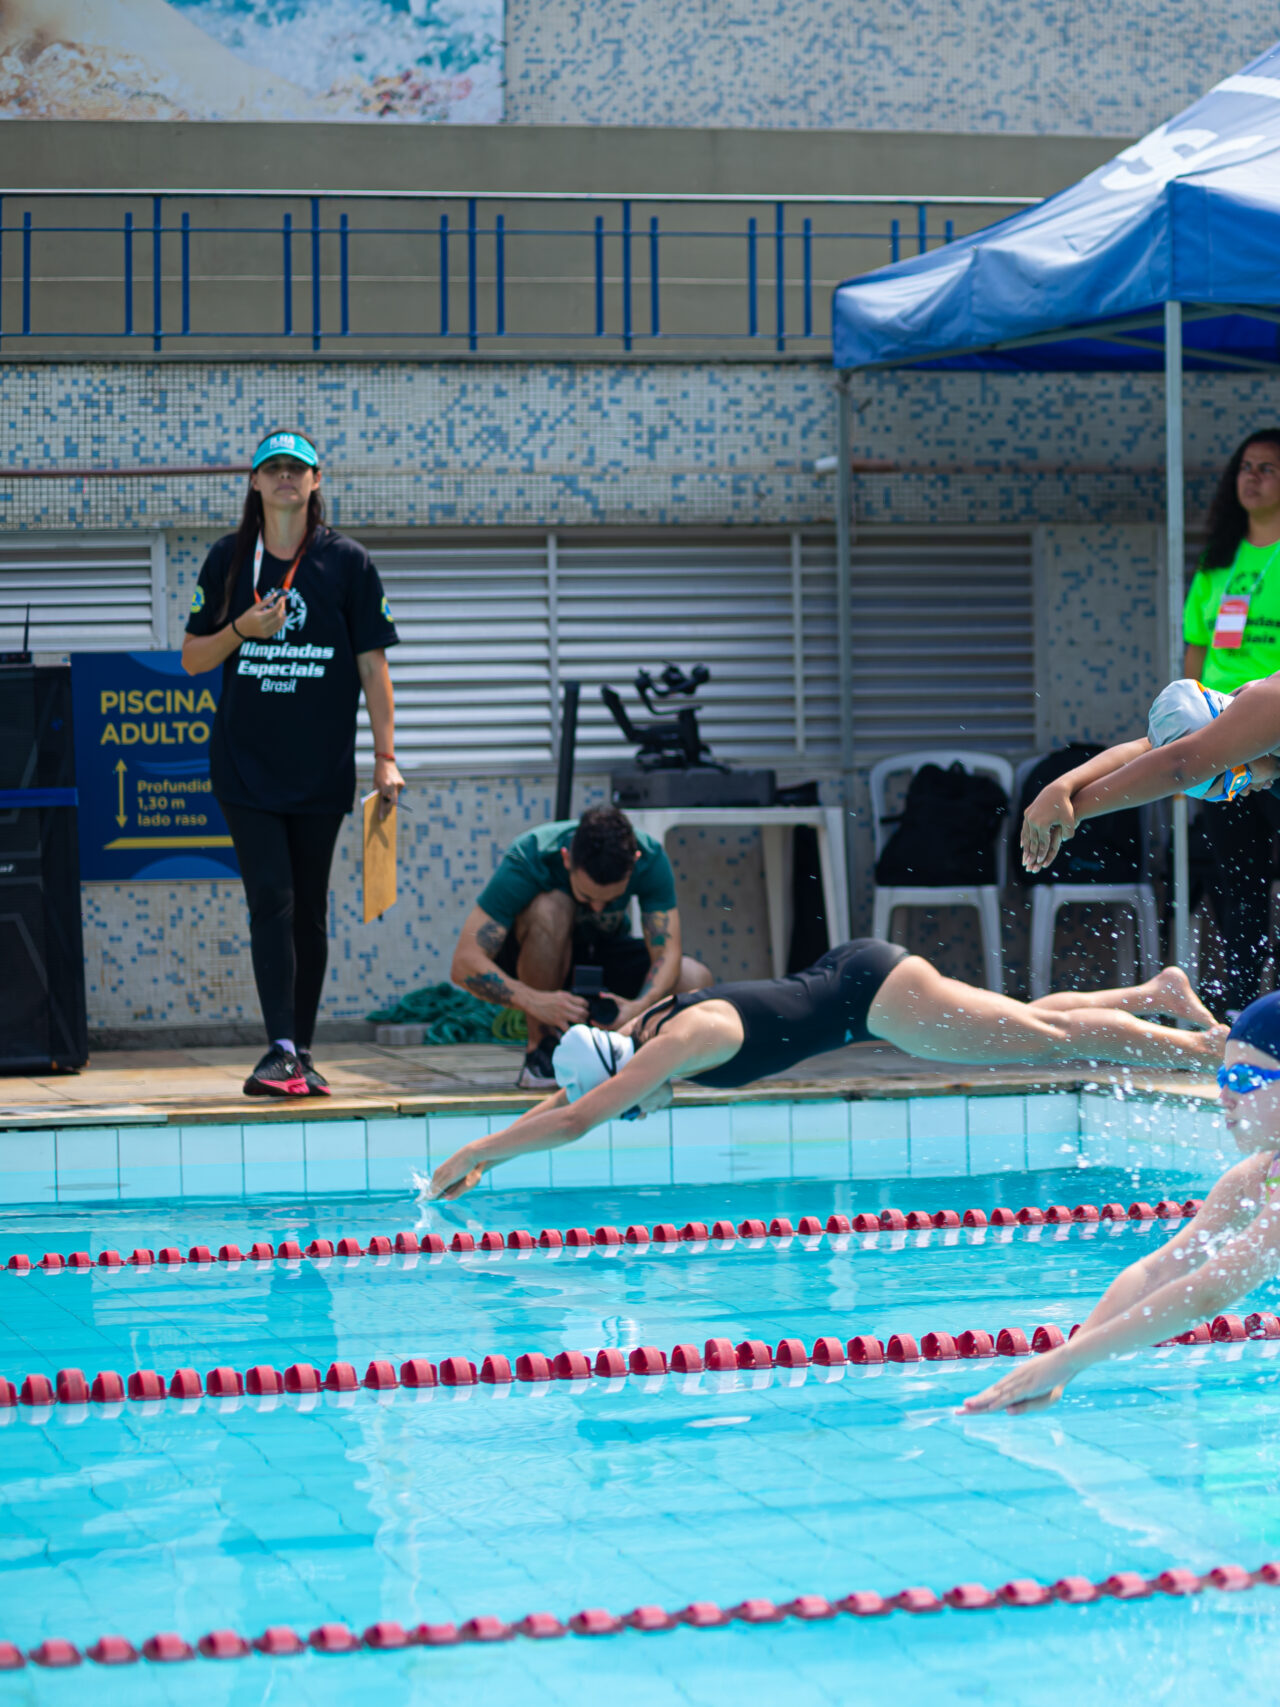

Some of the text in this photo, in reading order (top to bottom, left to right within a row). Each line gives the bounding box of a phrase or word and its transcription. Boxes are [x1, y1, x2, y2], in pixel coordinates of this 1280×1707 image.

[237, 660, 325, 678] Especiais
[261, 678, 297, 693] Brasil
[100, 688, 217, 715] PISCINA
[100, 720, 210, 745] ADULTO
[136, 796, 186, 811] 1,30 m
[137, 812, 208, 827] lado raso
